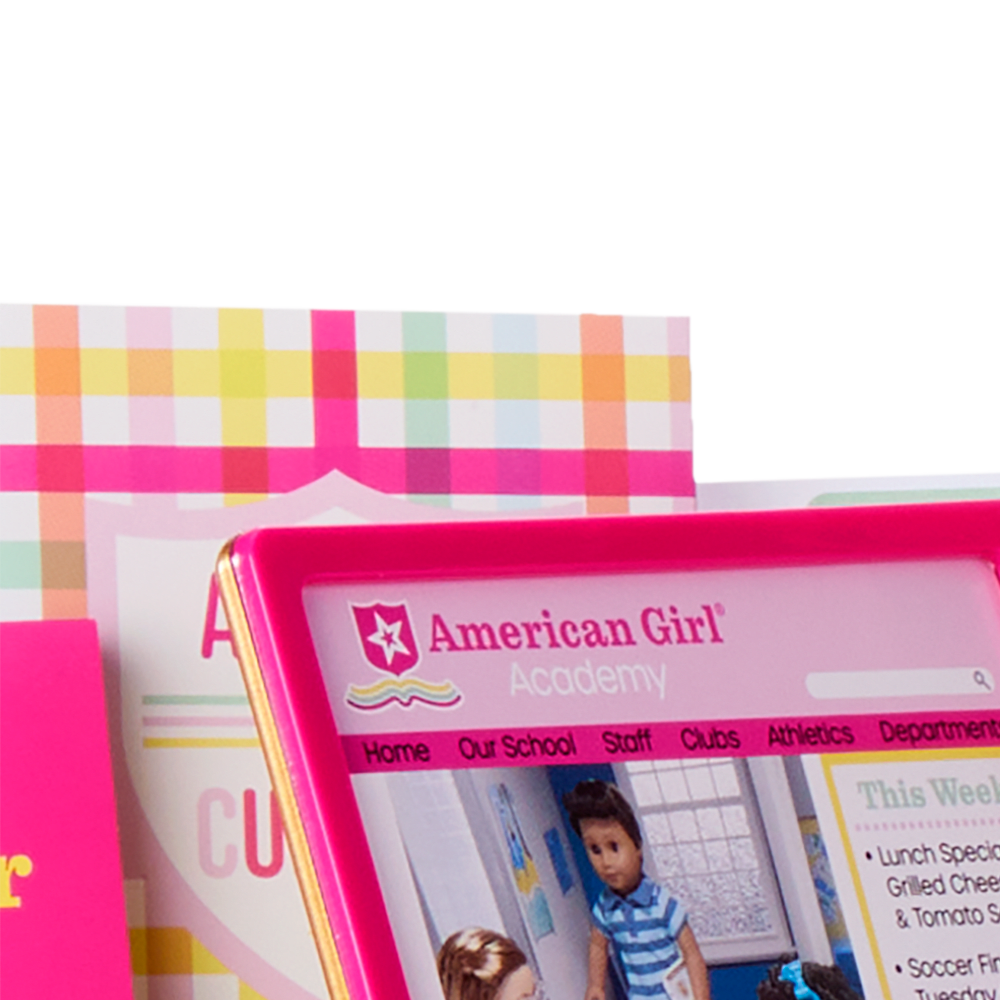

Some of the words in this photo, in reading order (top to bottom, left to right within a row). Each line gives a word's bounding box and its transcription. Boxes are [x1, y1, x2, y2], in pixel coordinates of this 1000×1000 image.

[429, 608, 637, 652] American
[509, 660, 668, 699] Academy
[362, 740, 431, 764] Home
[458, 736, 496, 760] Our
[502, 731, 578, 758] School
[601, 728, 652, 754] Staff
[680, 726, 741, 751] Clubs
[767, 722, 856, 748] Athletics
[857, 780, 927, 810] This
[877, 843, 937, 867] Lunch
[886, 873, 946, 897] Grilled
[896, 909, 910, 929] &
[912, 905, 984, 928] Tomato
[907, 957, 974, 978] Soccer
